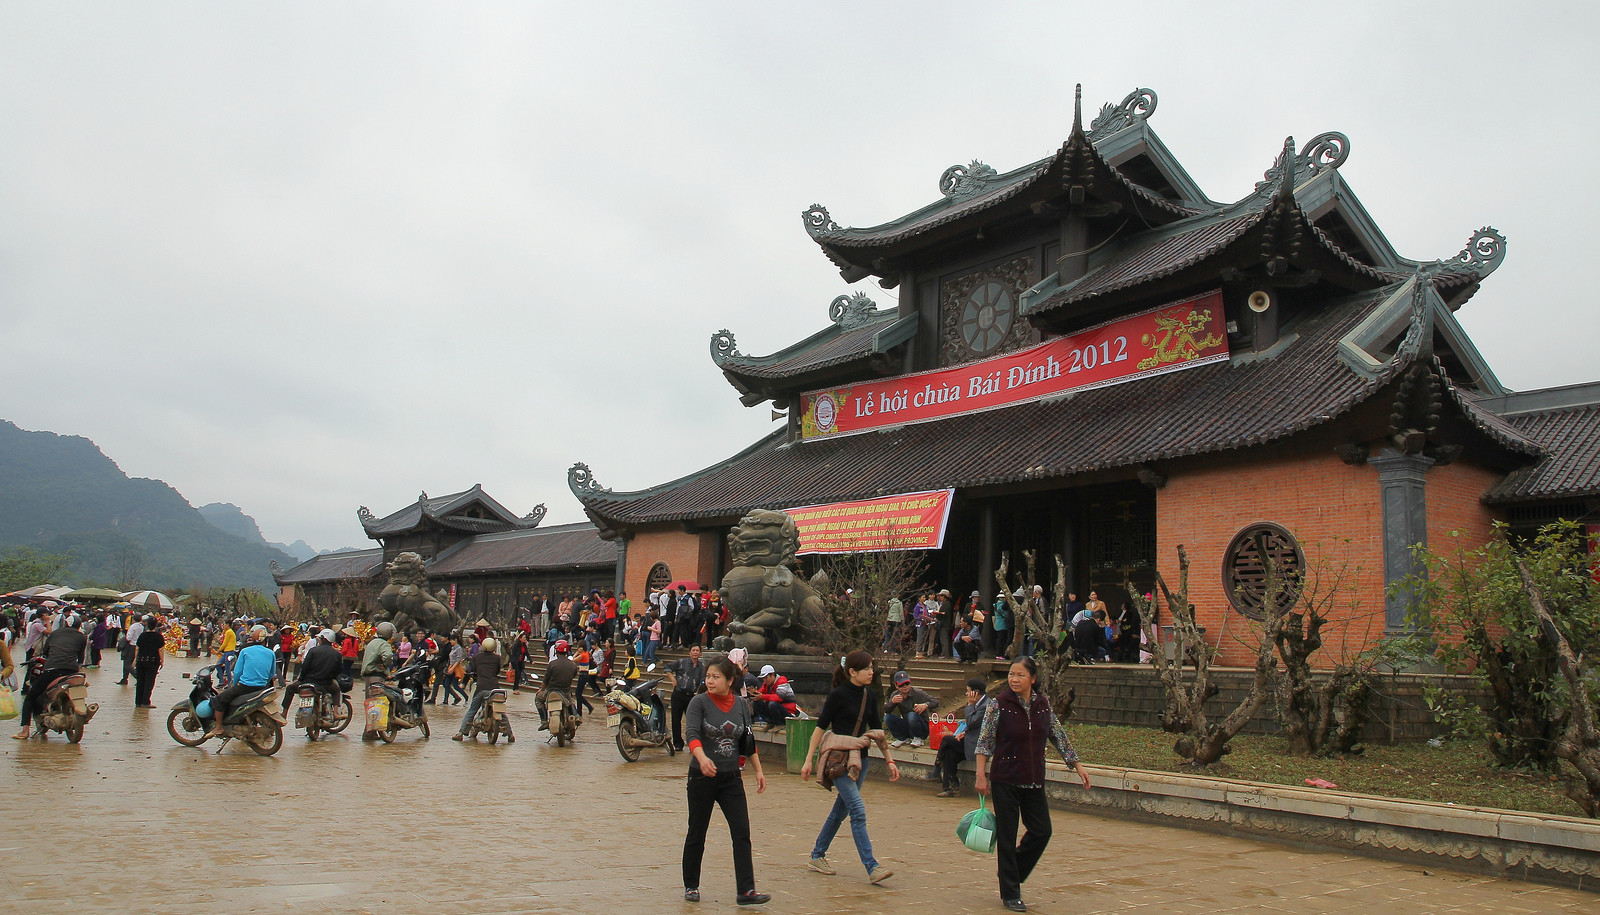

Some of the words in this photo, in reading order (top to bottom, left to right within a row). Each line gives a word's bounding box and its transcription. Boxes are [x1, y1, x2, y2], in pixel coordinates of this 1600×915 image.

[855, 391, 875, 418] Lễ
[879, 389, 909, 415] hội
[913, 382, 961, 409] chùa
[966, 370, 1001, 399] Bái
[1006, 354, 1062, 390] Đính
[1067, 335, 1129, 374] 2012
